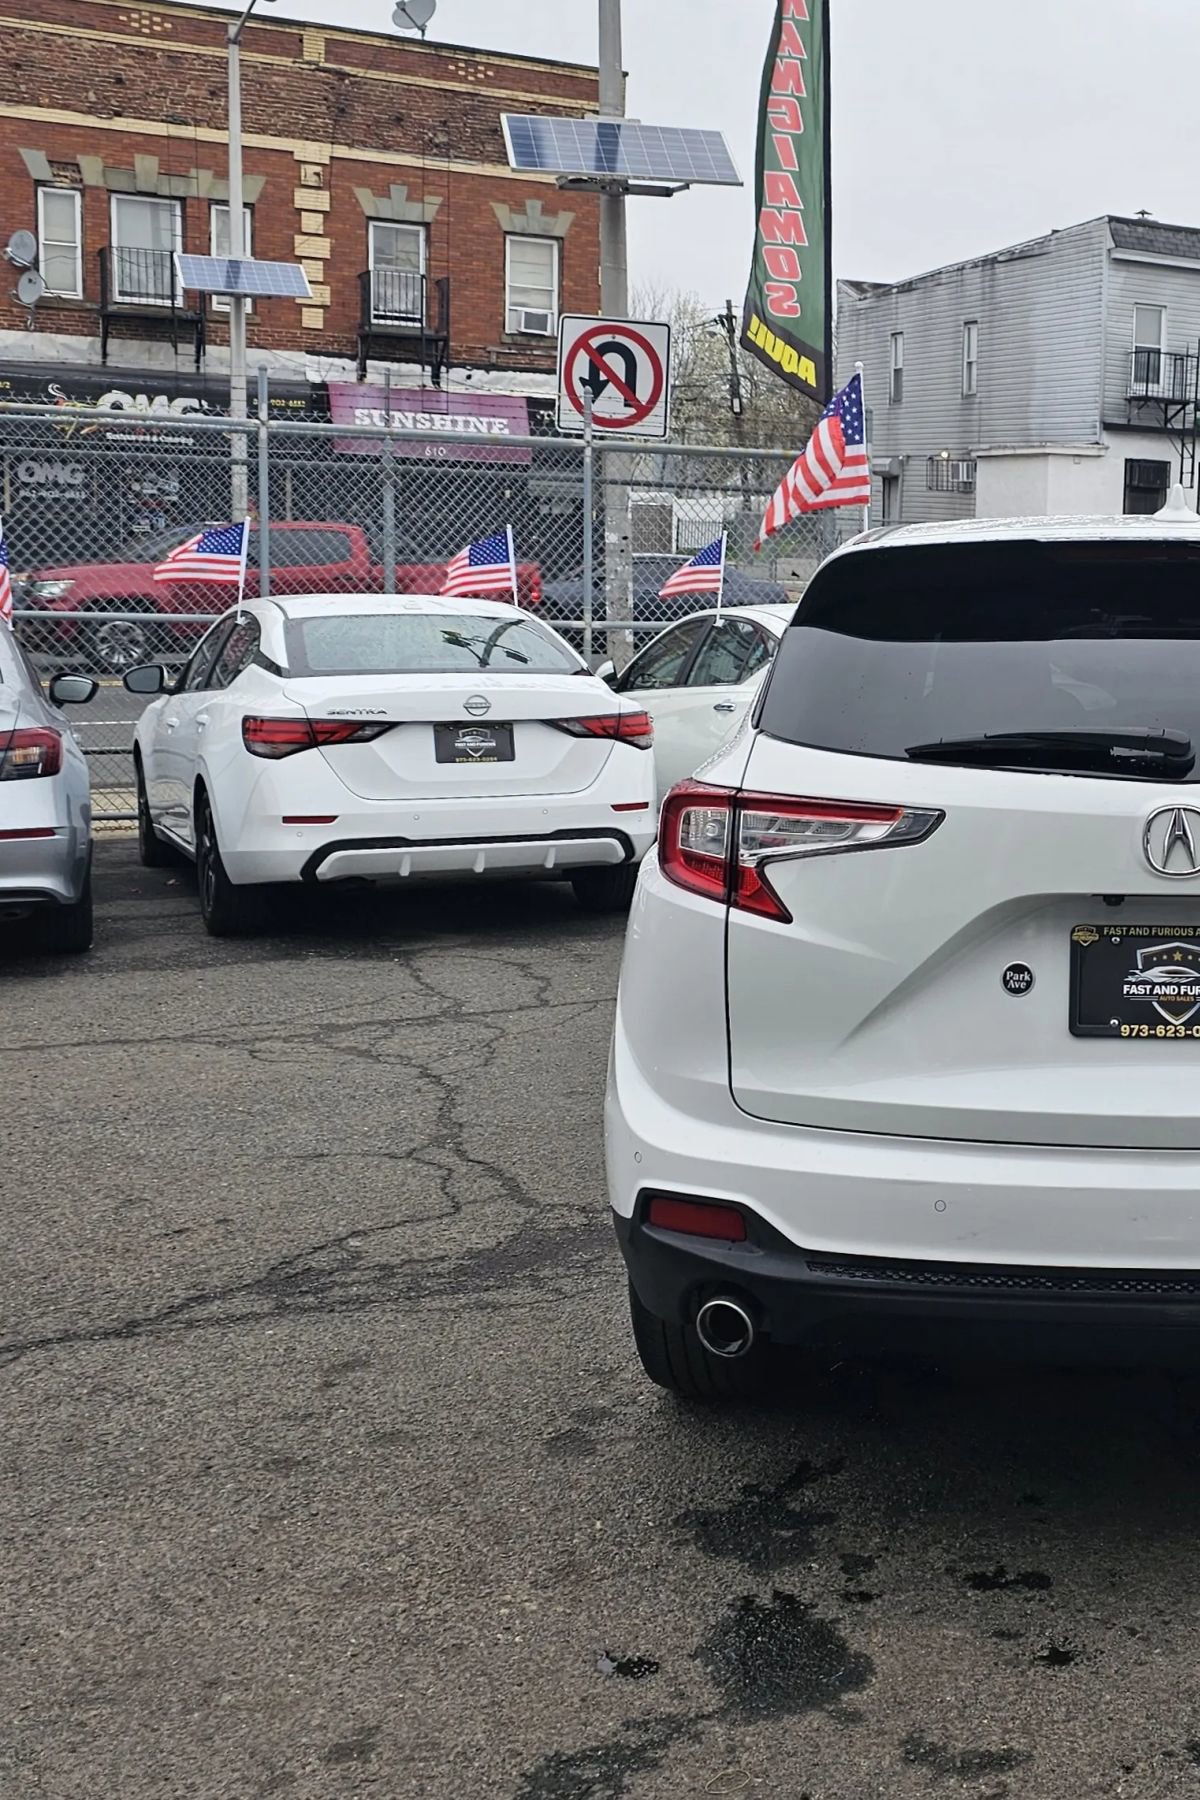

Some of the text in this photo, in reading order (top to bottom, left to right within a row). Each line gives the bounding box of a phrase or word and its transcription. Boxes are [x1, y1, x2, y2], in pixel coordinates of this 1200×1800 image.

[354, 408, 510, 435] SUNSHINE
[425, 446, 446, 457] 610
[18, 461, 88, 484] OMG
[1103, 927, 1127, 935] FAST
[1128, 927, 1150, 936] AND
[1151, 927, 1194, 936] FURIOUS
[1006, 970, 1031, 981] Park
[1007, 980, 1027, 989] Ave
[1123, 984, 1152, 995] FAST
[1152, 985, 1178, 995] AND
